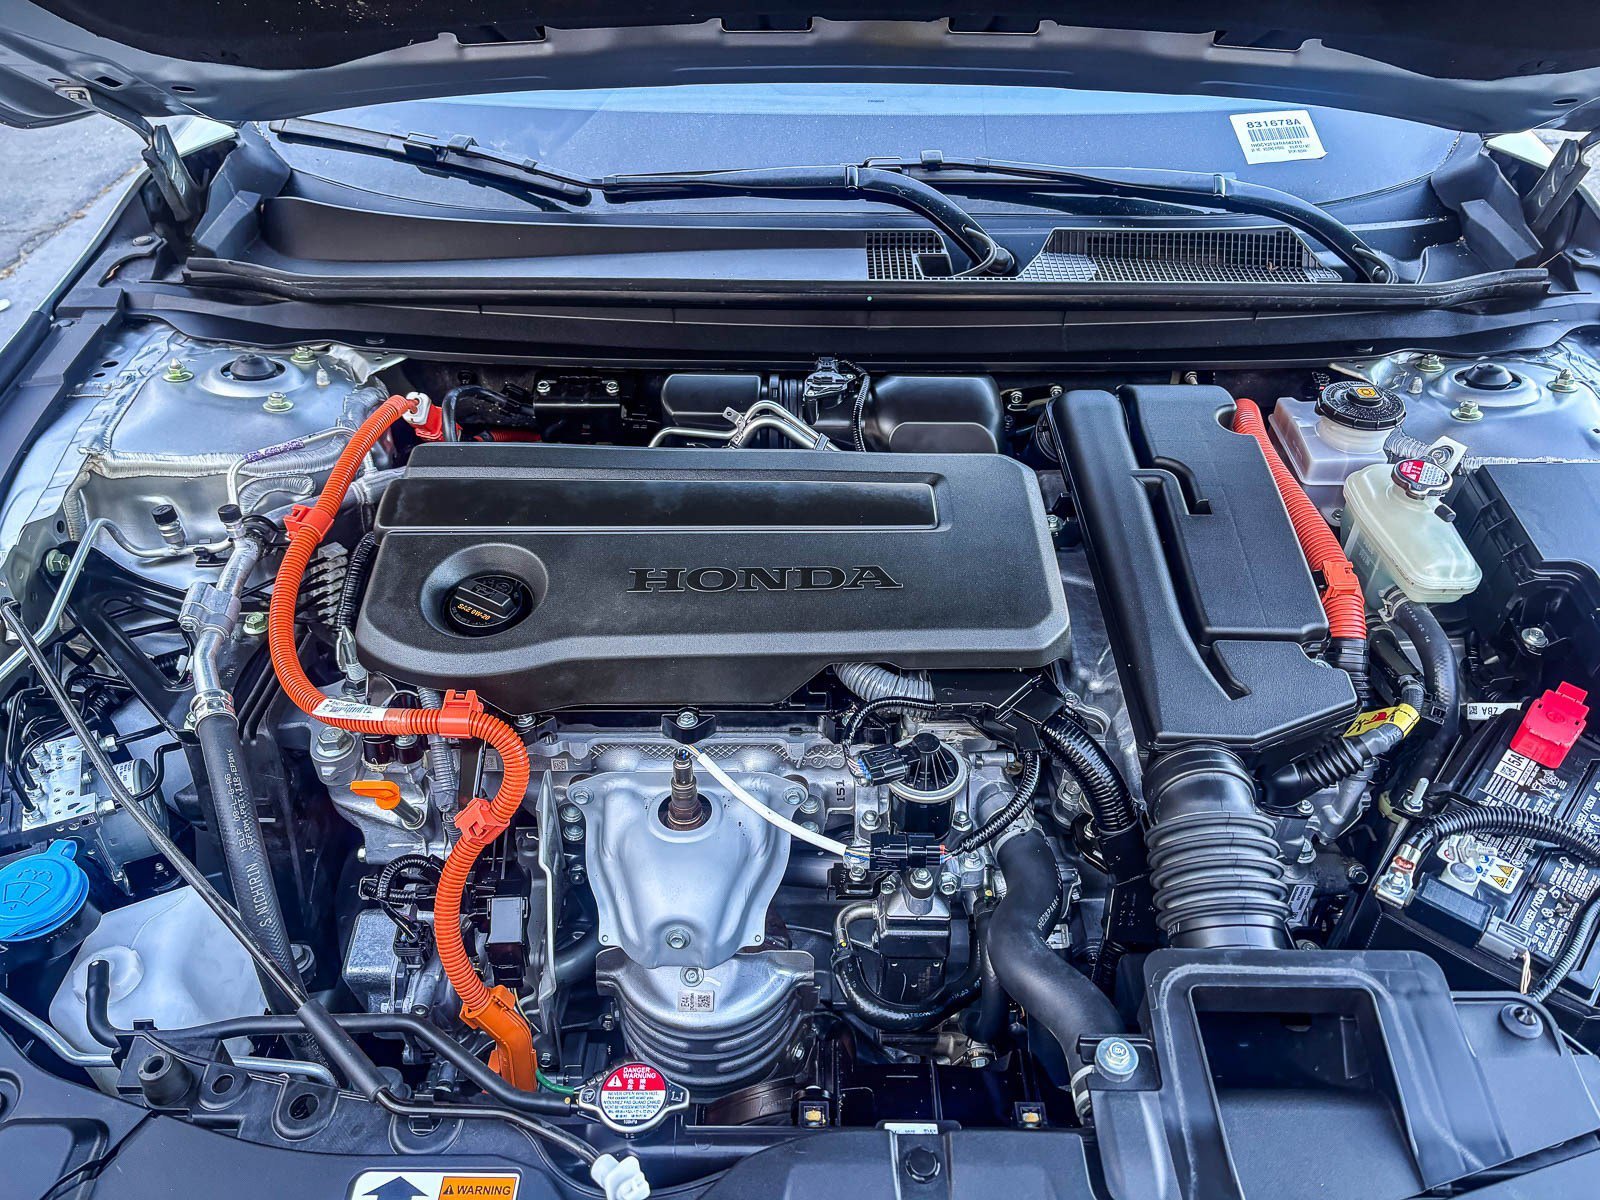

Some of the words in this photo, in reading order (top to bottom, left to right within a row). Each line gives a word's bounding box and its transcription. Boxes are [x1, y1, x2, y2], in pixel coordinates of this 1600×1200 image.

[626, 565, 904, 593] HONDA
[836, 779, 846, 802] 151
[456, 1185, 511, 1196] WARNING
